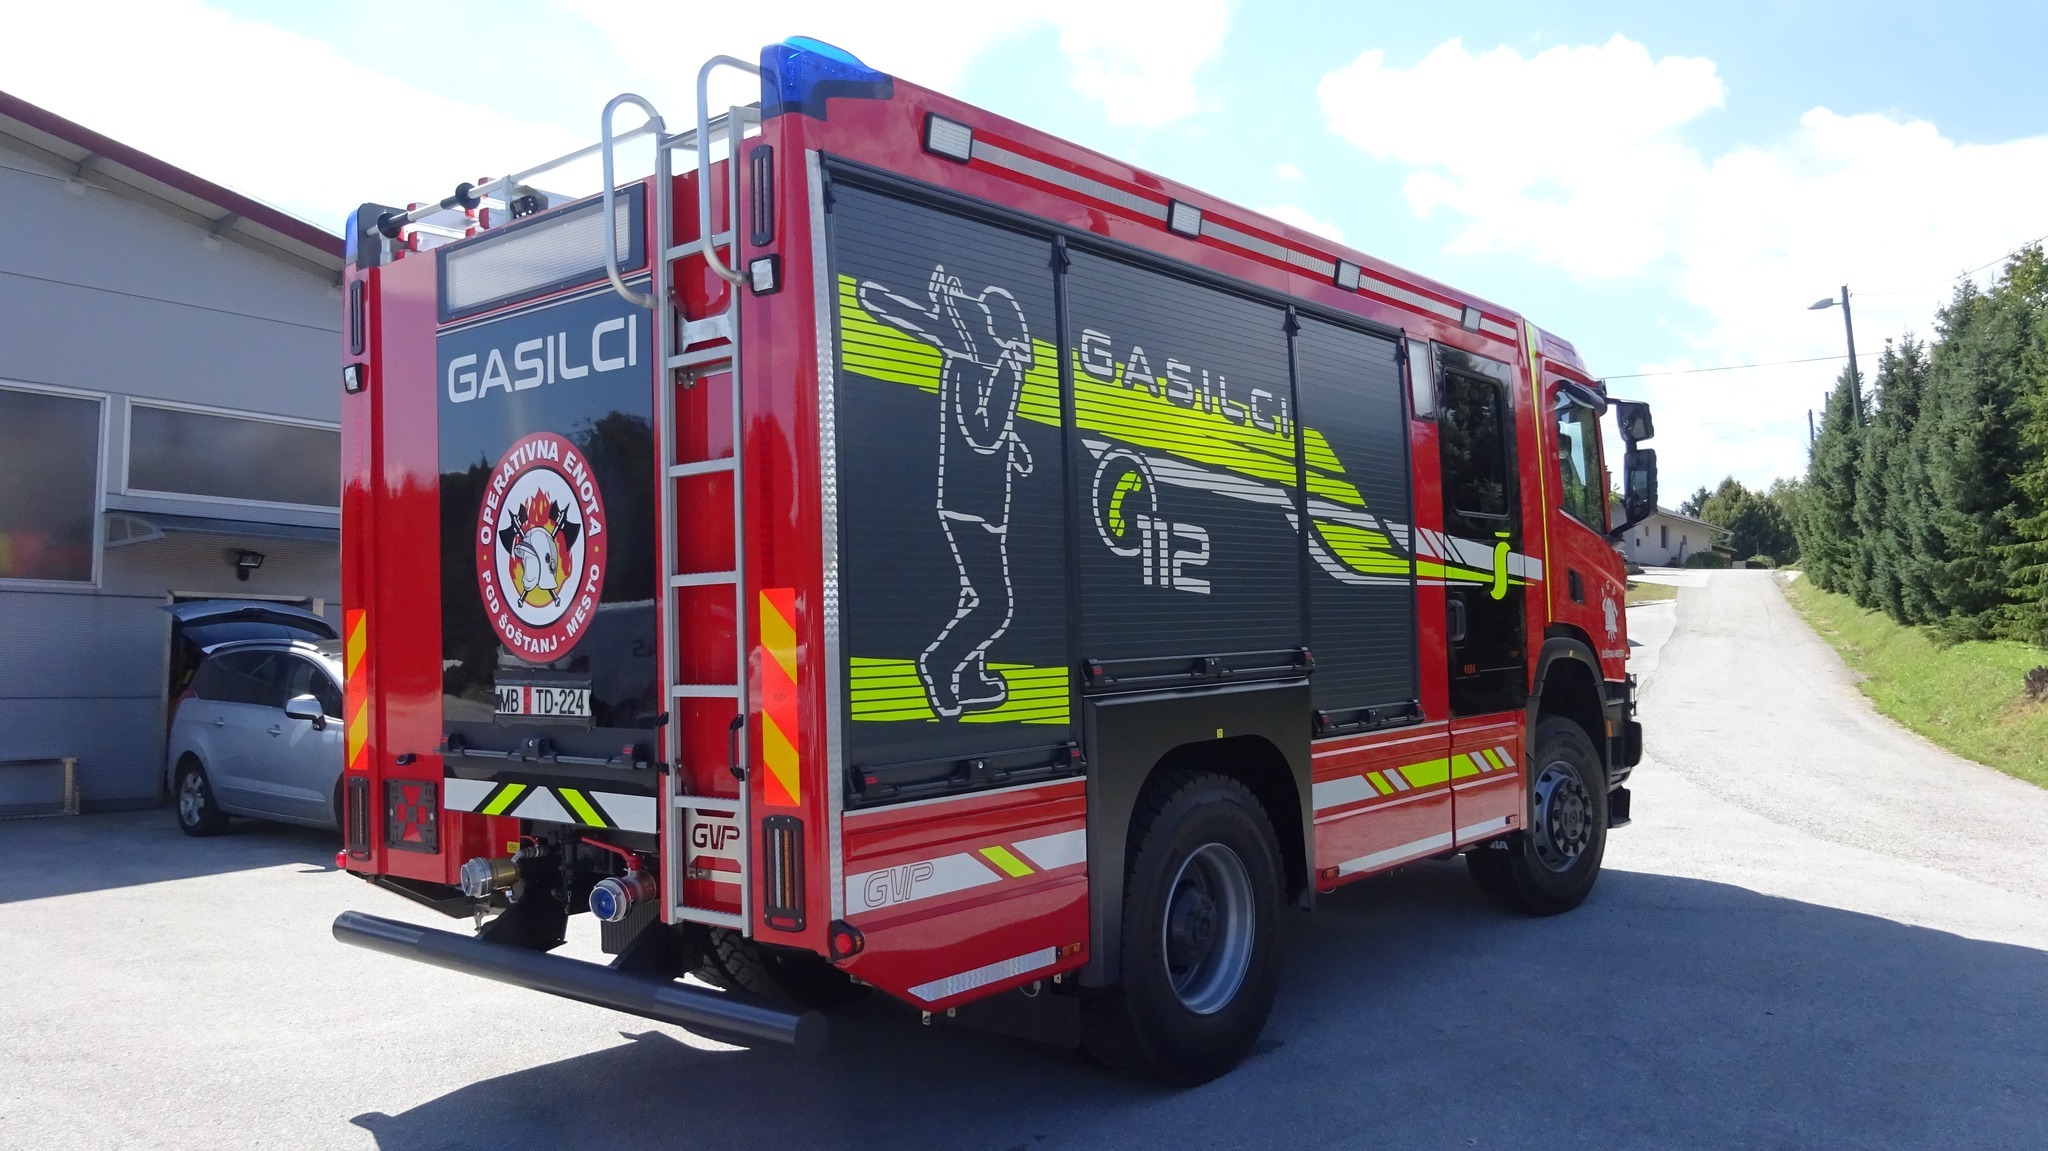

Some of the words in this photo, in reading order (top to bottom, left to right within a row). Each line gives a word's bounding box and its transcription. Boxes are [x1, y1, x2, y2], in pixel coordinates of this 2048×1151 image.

[448, 314, 637, 403] GASILCI
[1081, 328, 1291, 439] GASILCI
[481, 440, 559, 545] OPERATIVNA
[563, 451, 602, 537] ENOTA
[482, 569, 500, 614] PGD
[499, 612, 557, 653] ŠOŠTANJ
[566, 564, 600, 638] MESTO
[499, 688, 520, 712] MB
[536, 689, 584, 715] TD-224
[691, 822, 741, 851] GVP
[863, 861, 934, 908] GVP
